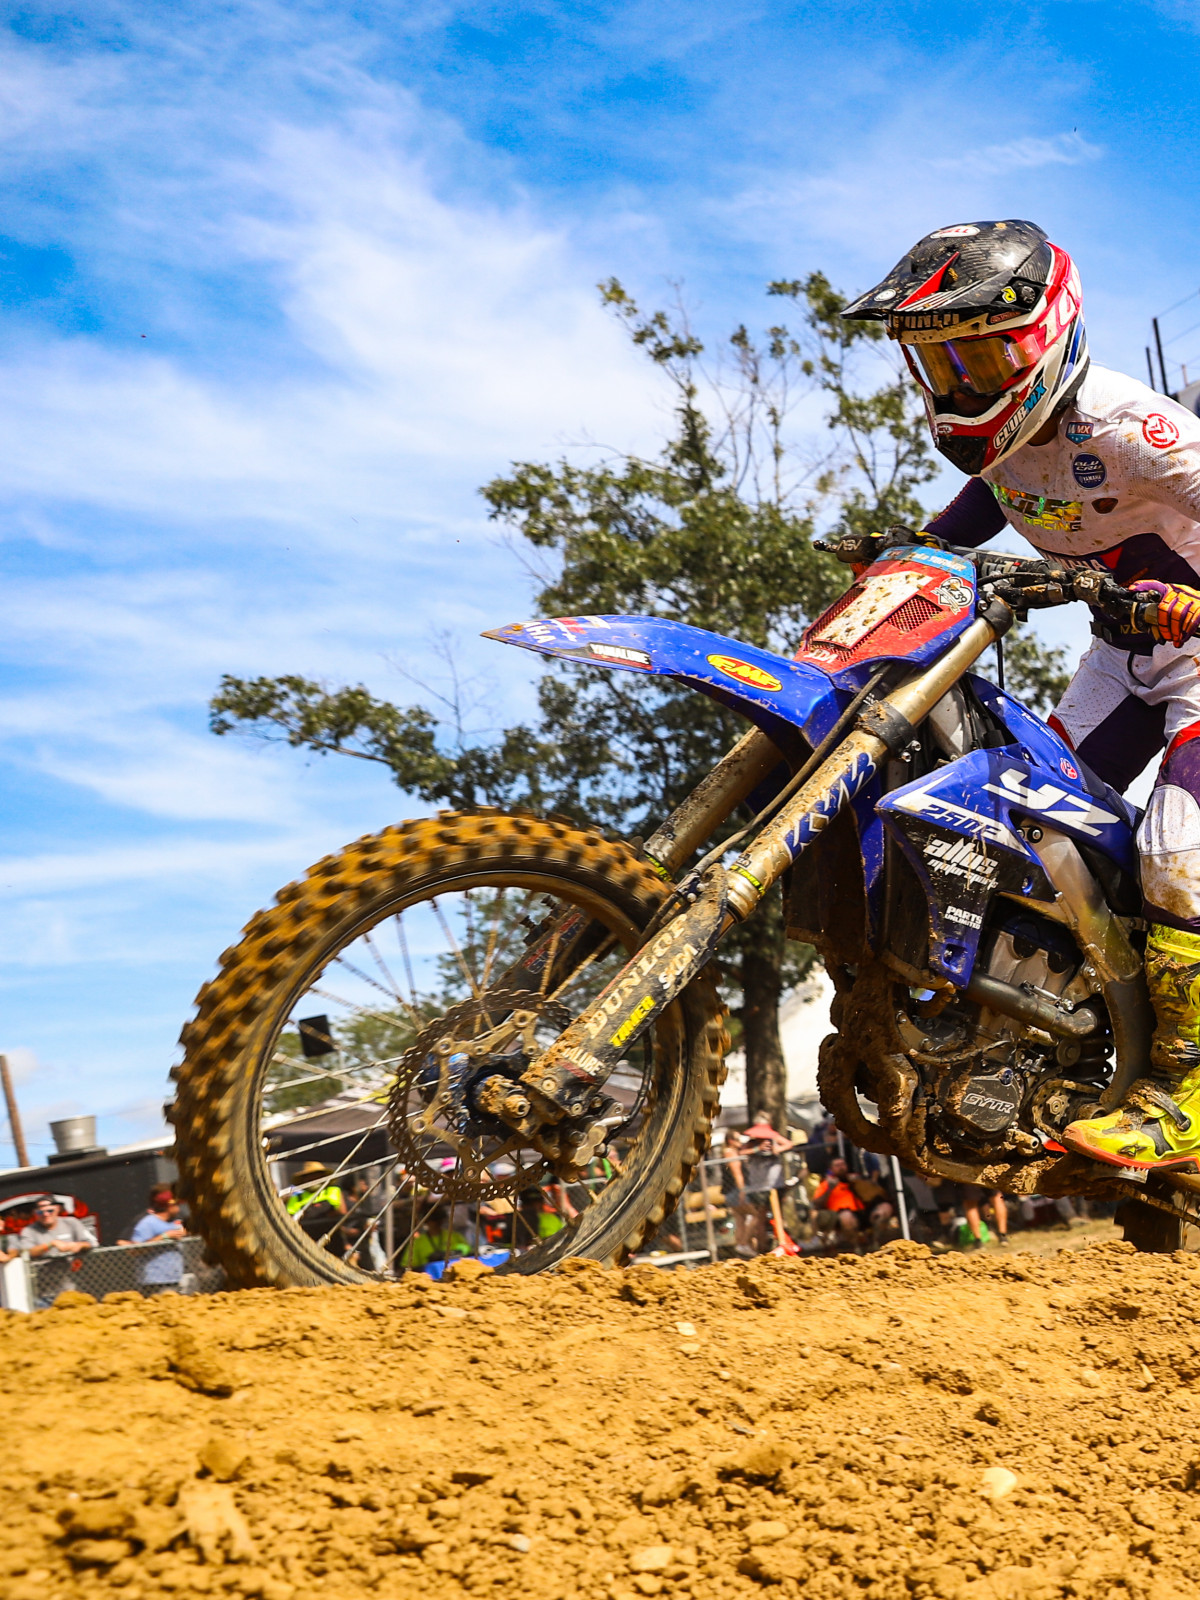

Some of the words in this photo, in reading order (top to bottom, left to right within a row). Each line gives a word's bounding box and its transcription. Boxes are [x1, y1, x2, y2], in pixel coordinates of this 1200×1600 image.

[946, 905, 983, 925] PARTS
[584, 913, 688, 1040] DUNLOP
[963, 1092, 1016, 1114] GYTR
